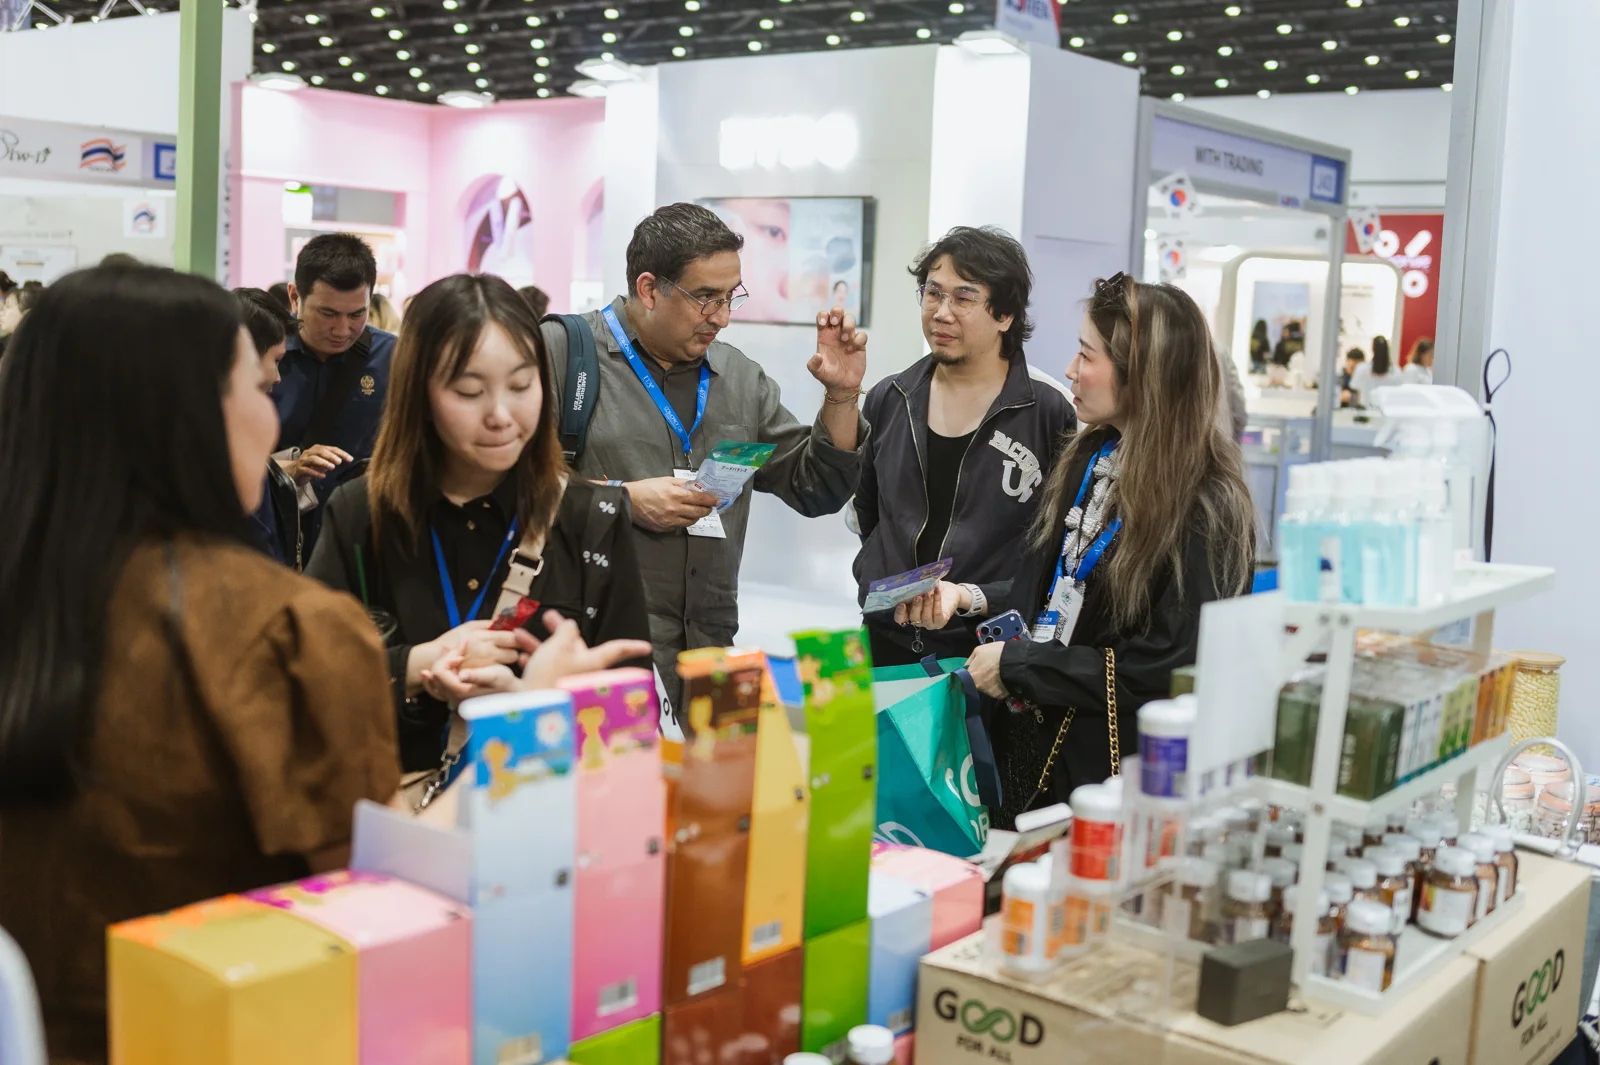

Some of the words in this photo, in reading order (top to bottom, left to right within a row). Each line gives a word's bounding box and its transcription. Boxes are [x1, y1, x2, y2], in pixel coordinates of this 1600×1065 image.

[1223, 151, 1264, 176] TRADING
[572, 371, 583, 411] TOURISTER
[578, 371, 588, 411] AMERICAN
[1512, 948, 1564, 1029] GOOD
[933, 987, 1045, 1046] GOOD
[956, 1034, 983, 1053] FOR
[989, 1046, 1013, 1063] ALL
